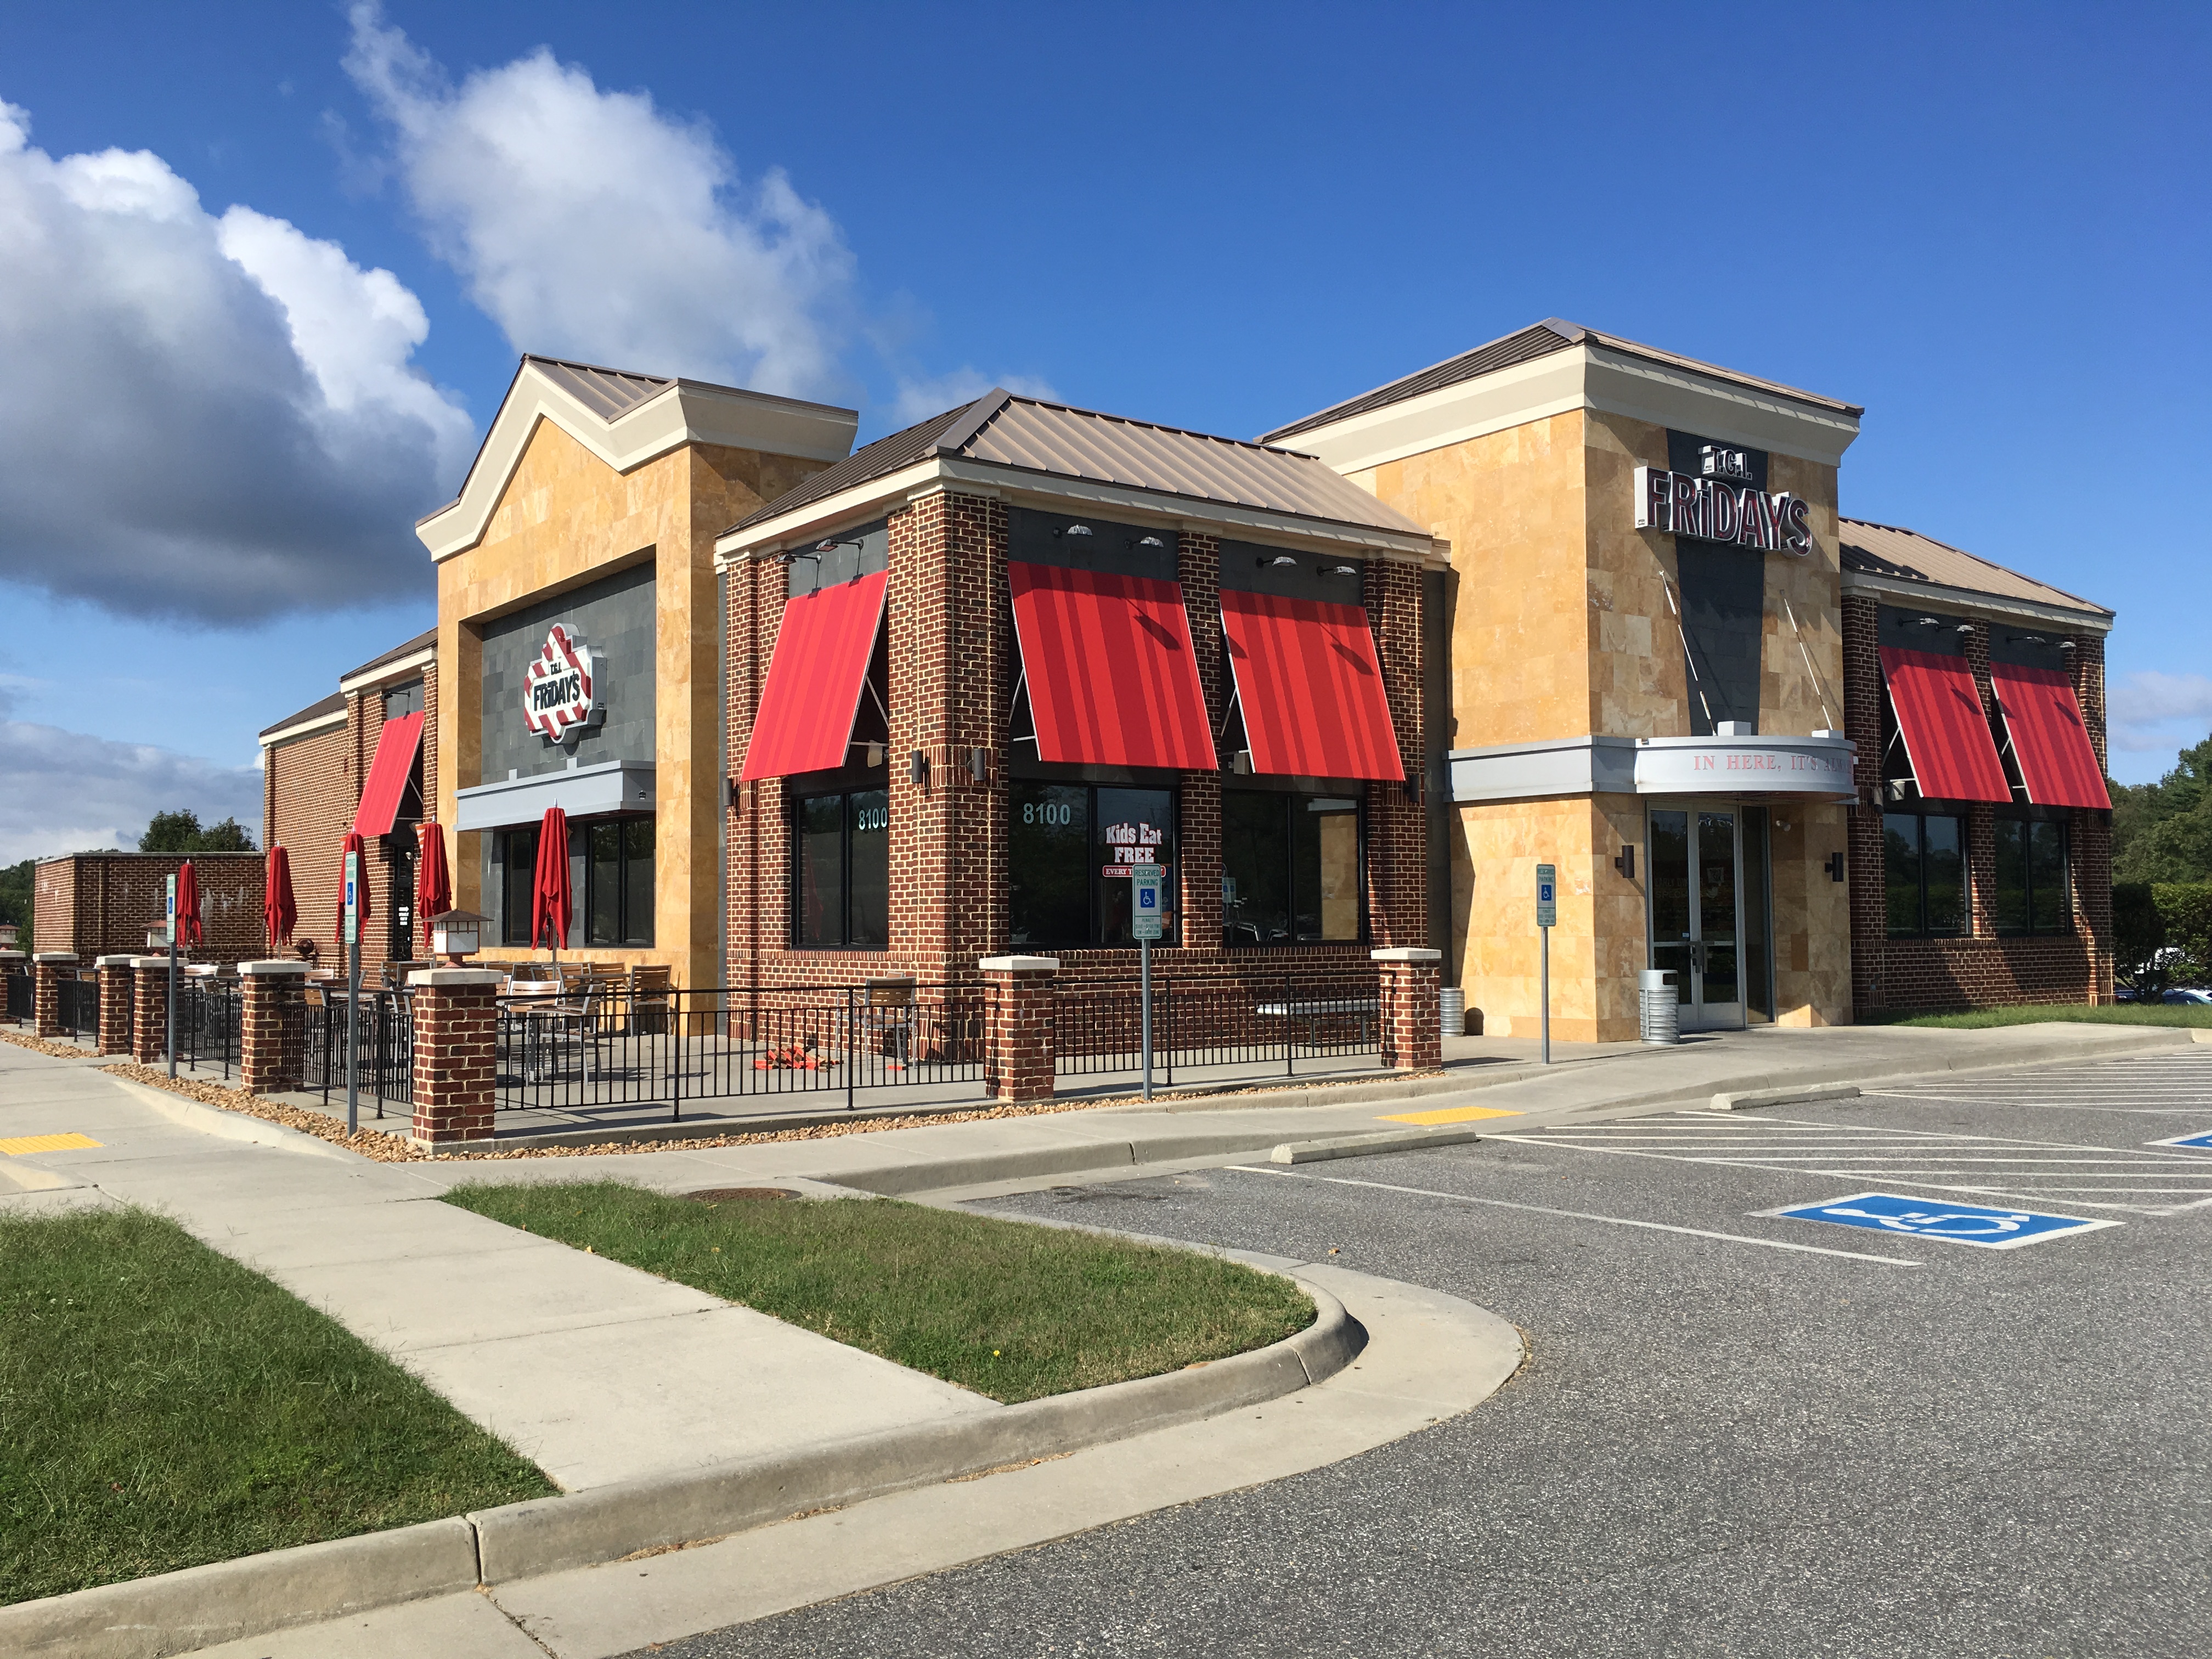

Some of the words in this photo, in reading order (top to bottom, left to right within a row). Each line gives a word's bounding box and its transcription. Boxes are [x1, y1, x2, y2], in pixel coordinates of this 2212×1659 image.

[1694, 756, 1716, 770] IN
[1726, 755, 1781, 771] HERE,
[1791, 755, 1818, 771] IT'S
[859, 806, 888, 830] 8100
[1023, 803, 1070, 825] 8100
[1105, 822, 1136, 844] Kids
[1139, 822, 1162, 844] Eat
[1114, 847, 1155, 863] FREE
